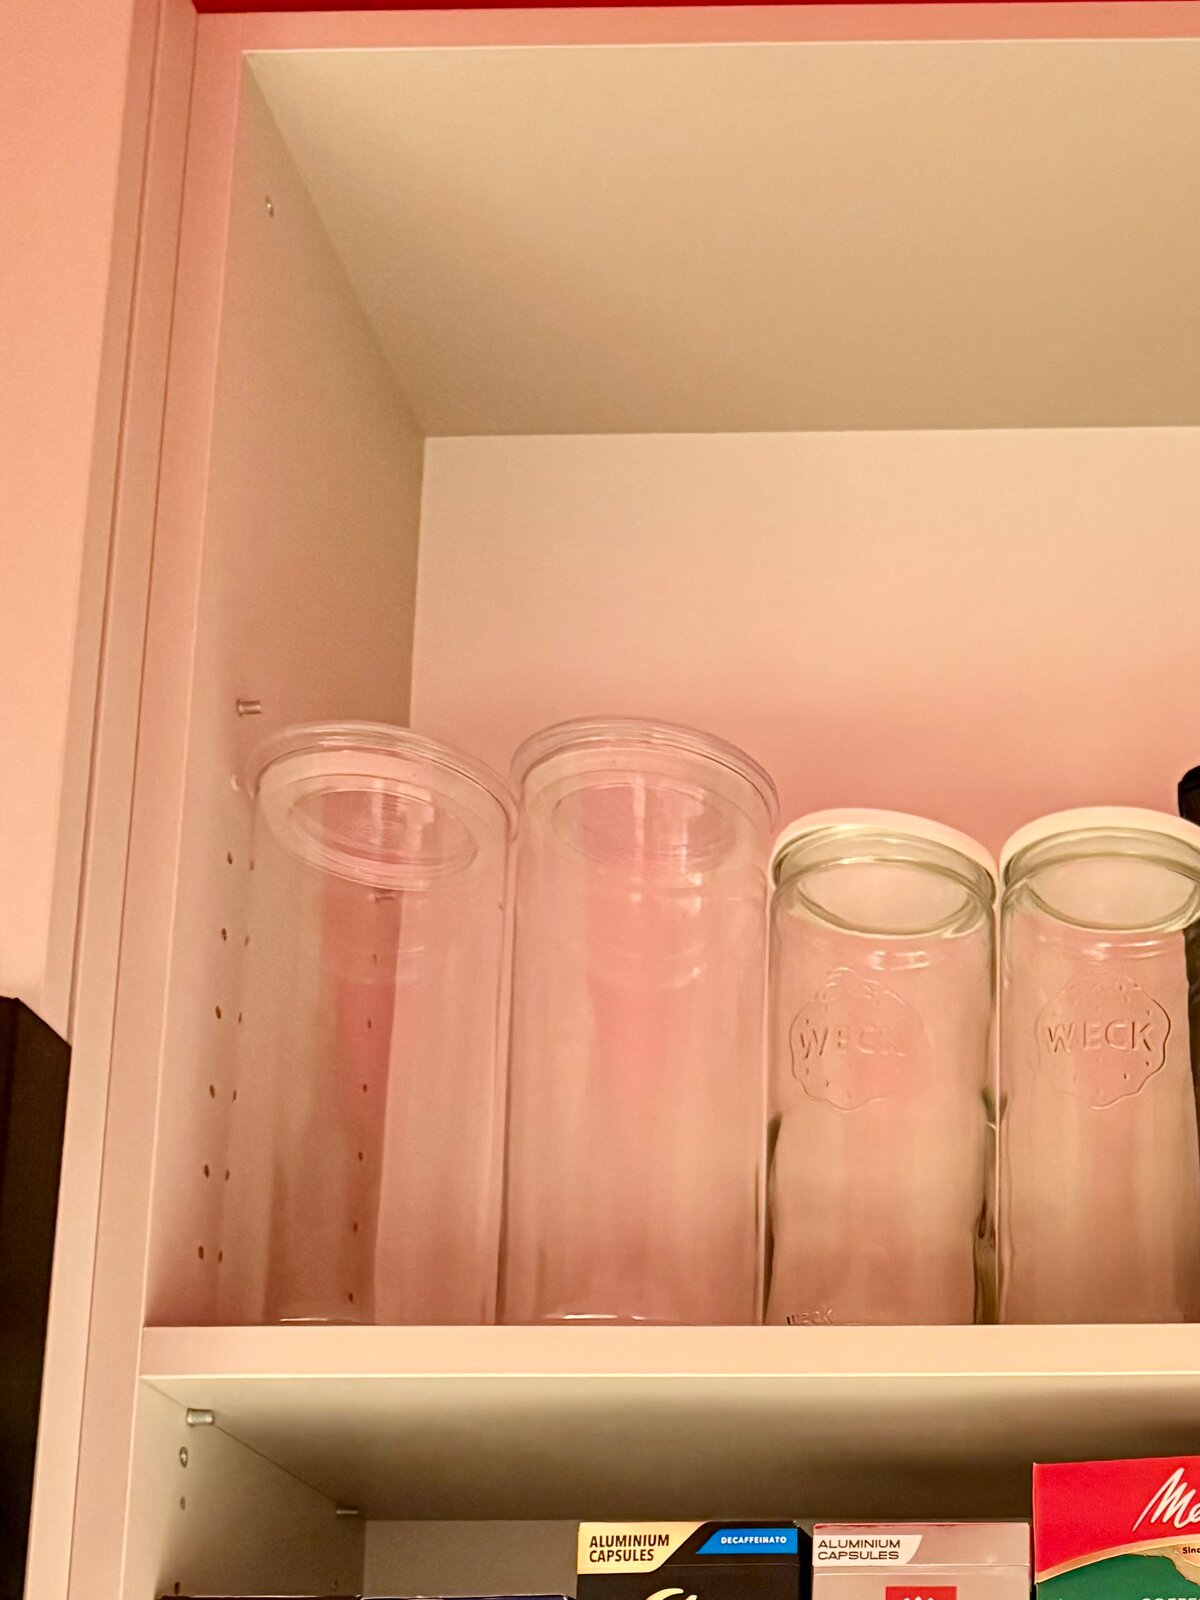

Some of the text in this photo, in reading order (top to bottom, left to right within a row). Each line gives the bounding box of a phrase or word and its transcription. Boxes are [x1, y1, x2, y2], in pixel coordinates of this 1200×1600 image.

[1047, 1020, 1155, 1053] WECK
[589, 1534, 670, 1548] ALUMINIUM
[720, 1536, 787, 1545] DECAFFEINATO
[817, 1539, 901, 1549] ALUMINIUM
[589, 1548, 655, 1563] CAPSULES
[817, 1551, 900, 1560] CAPSULES
